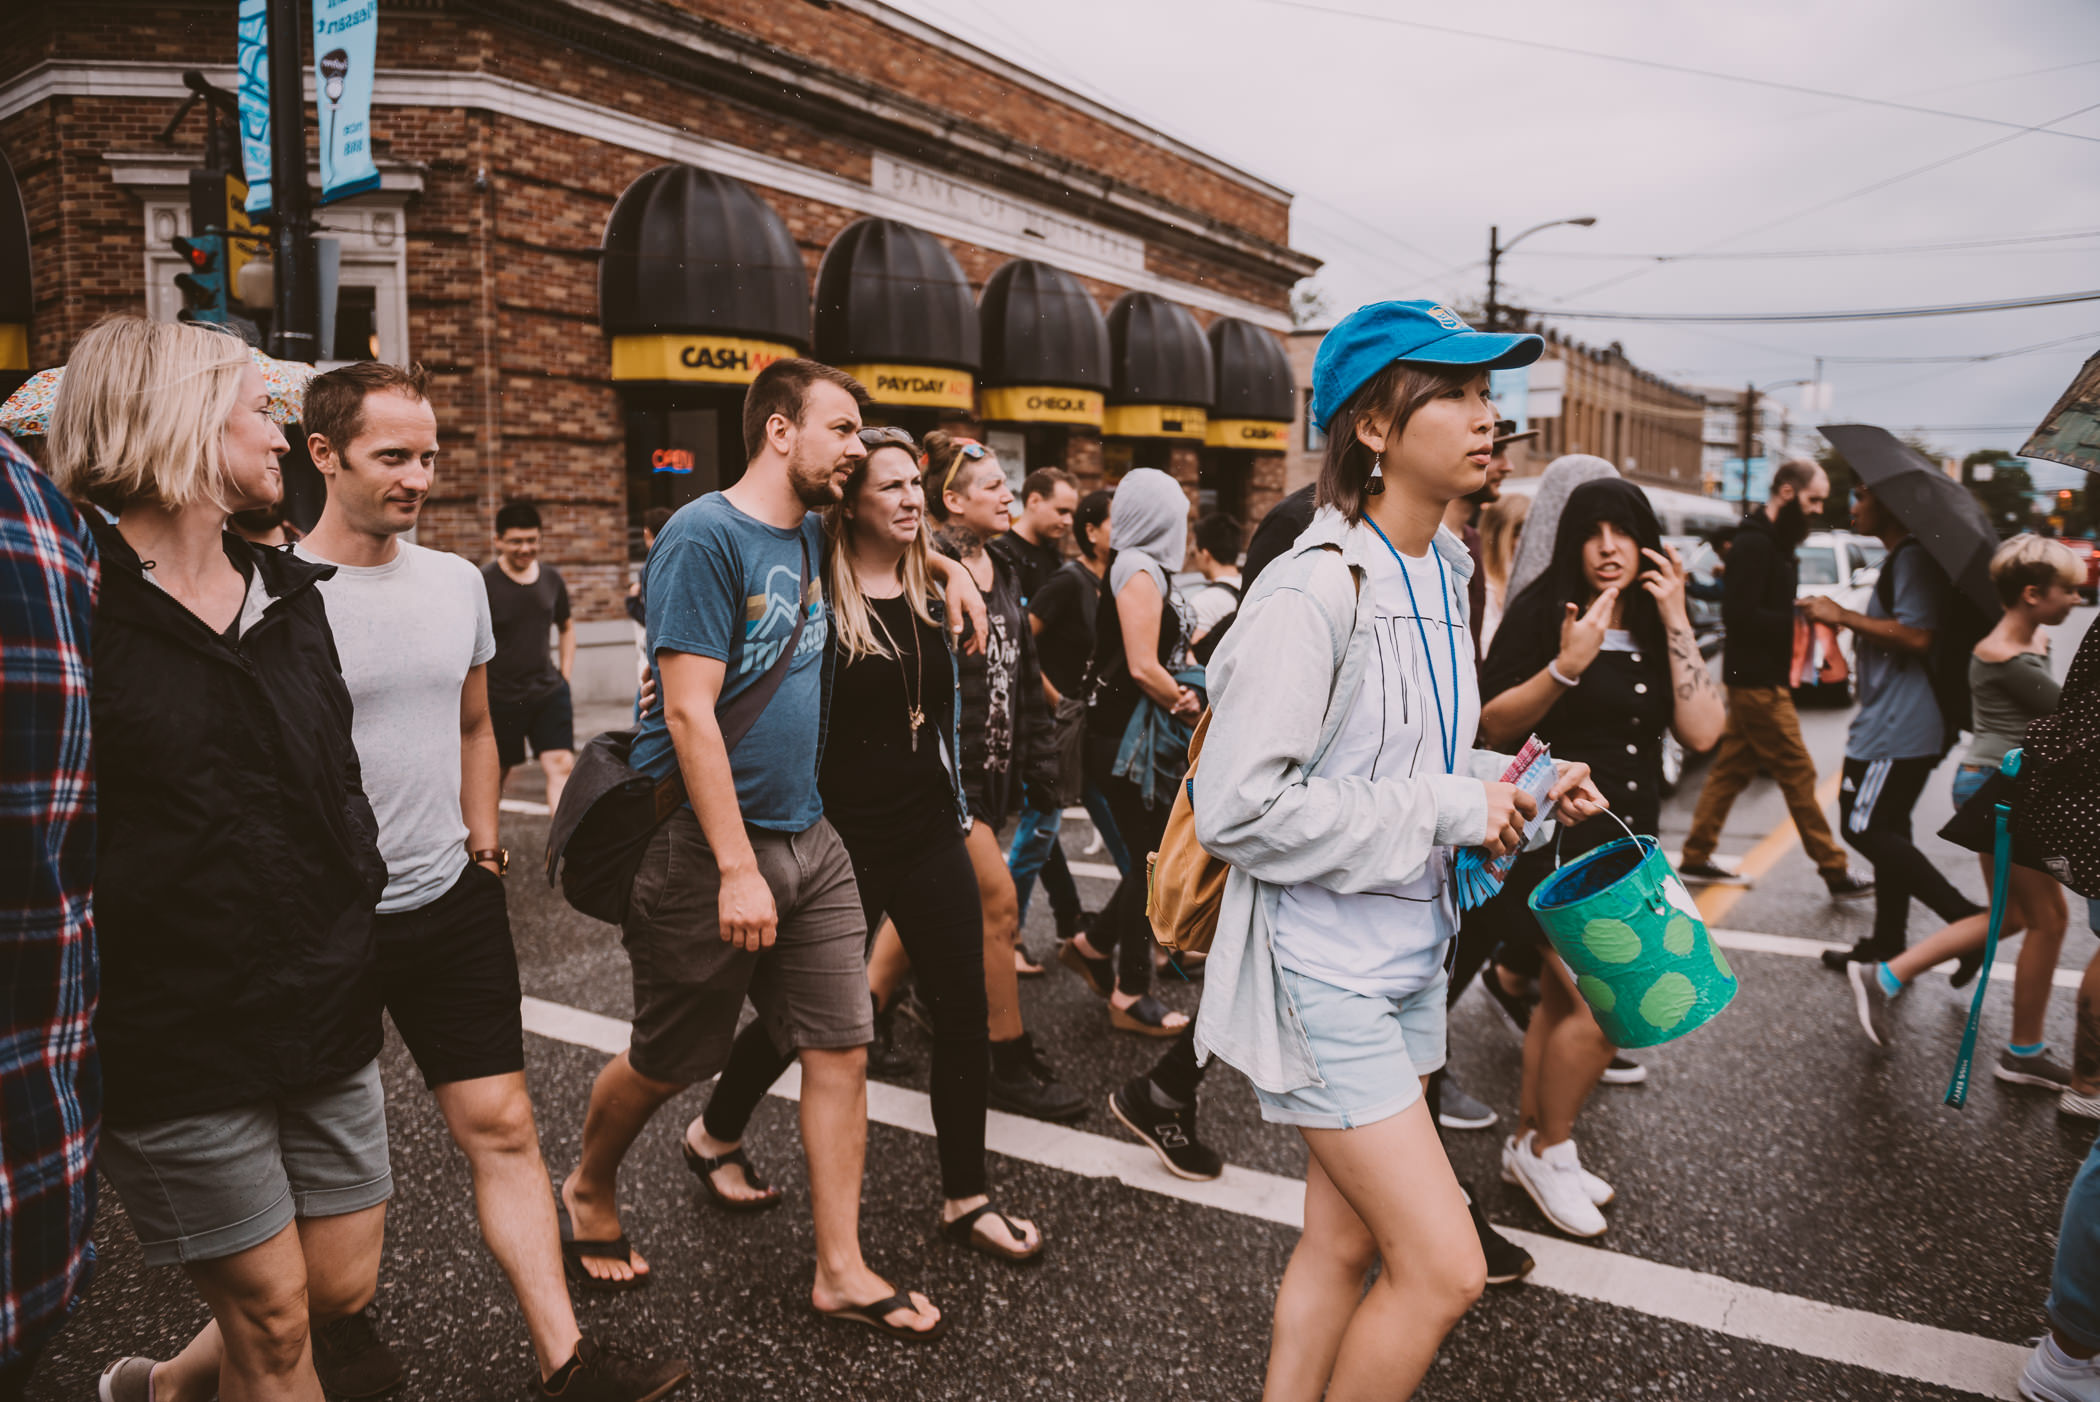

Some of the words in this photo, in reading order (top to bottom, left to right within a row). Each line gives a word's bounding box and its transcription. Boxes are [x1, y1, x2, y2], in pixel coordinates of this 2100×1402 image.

[892, 163, 958, 206] BANK
[978, 193, 1006, 219] OF
[681, 346, 748, 370] CASH
[877, 375, 945, 393] PAYDAY
[1027, 395, 1085, 411] CHEQUE
[652, 449, 694, 470] OPEN
